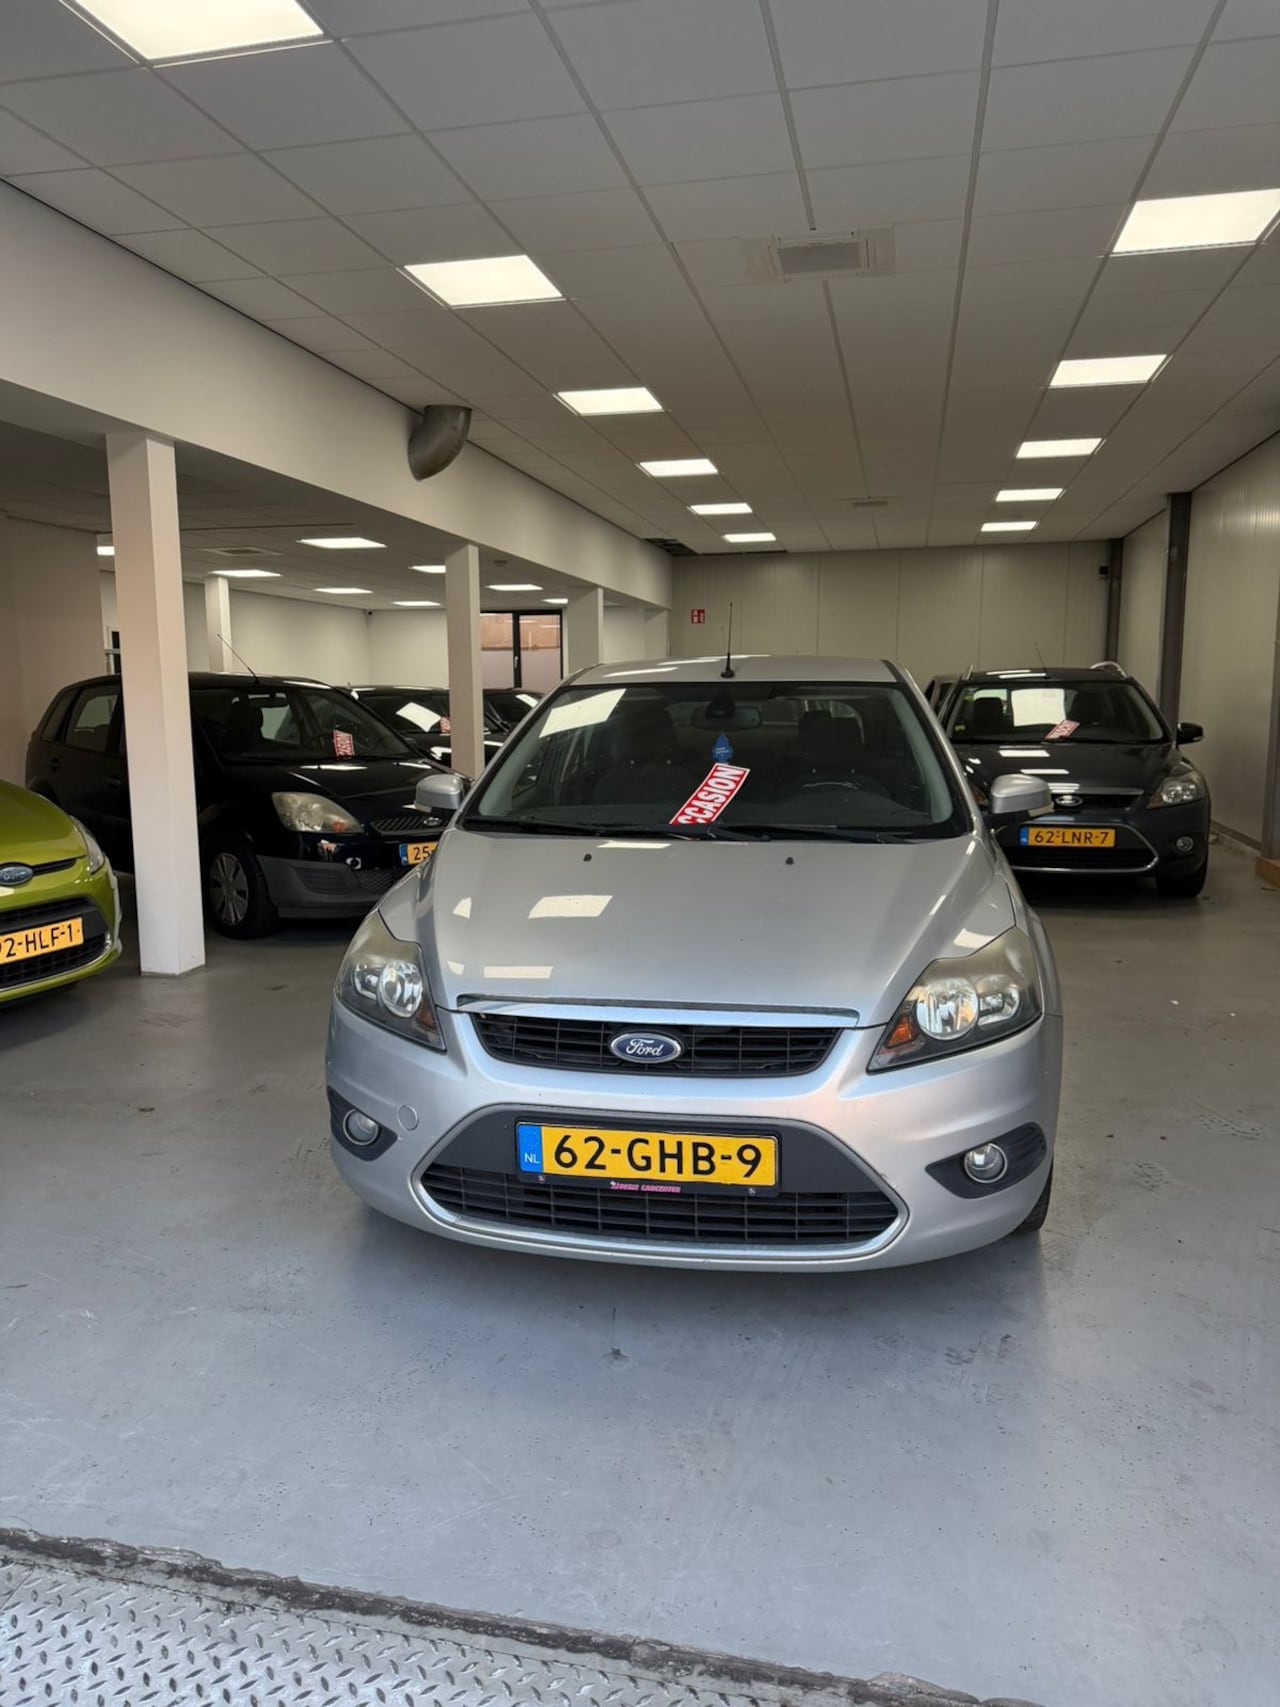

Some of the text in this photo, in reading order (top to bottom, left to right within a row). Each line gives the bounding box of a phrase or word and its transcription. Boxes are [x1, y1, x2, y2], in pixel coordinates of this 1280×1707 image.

[1034, 830, 1109, 844] 62-LNR-7
[0, 923, 73, 958] 2-HLF-1
[625, 1038, 665, 1057] Ford
[524, 1153, 540, 1165] NL
[554, 1134, 762, 1178] 62-GHB-9
